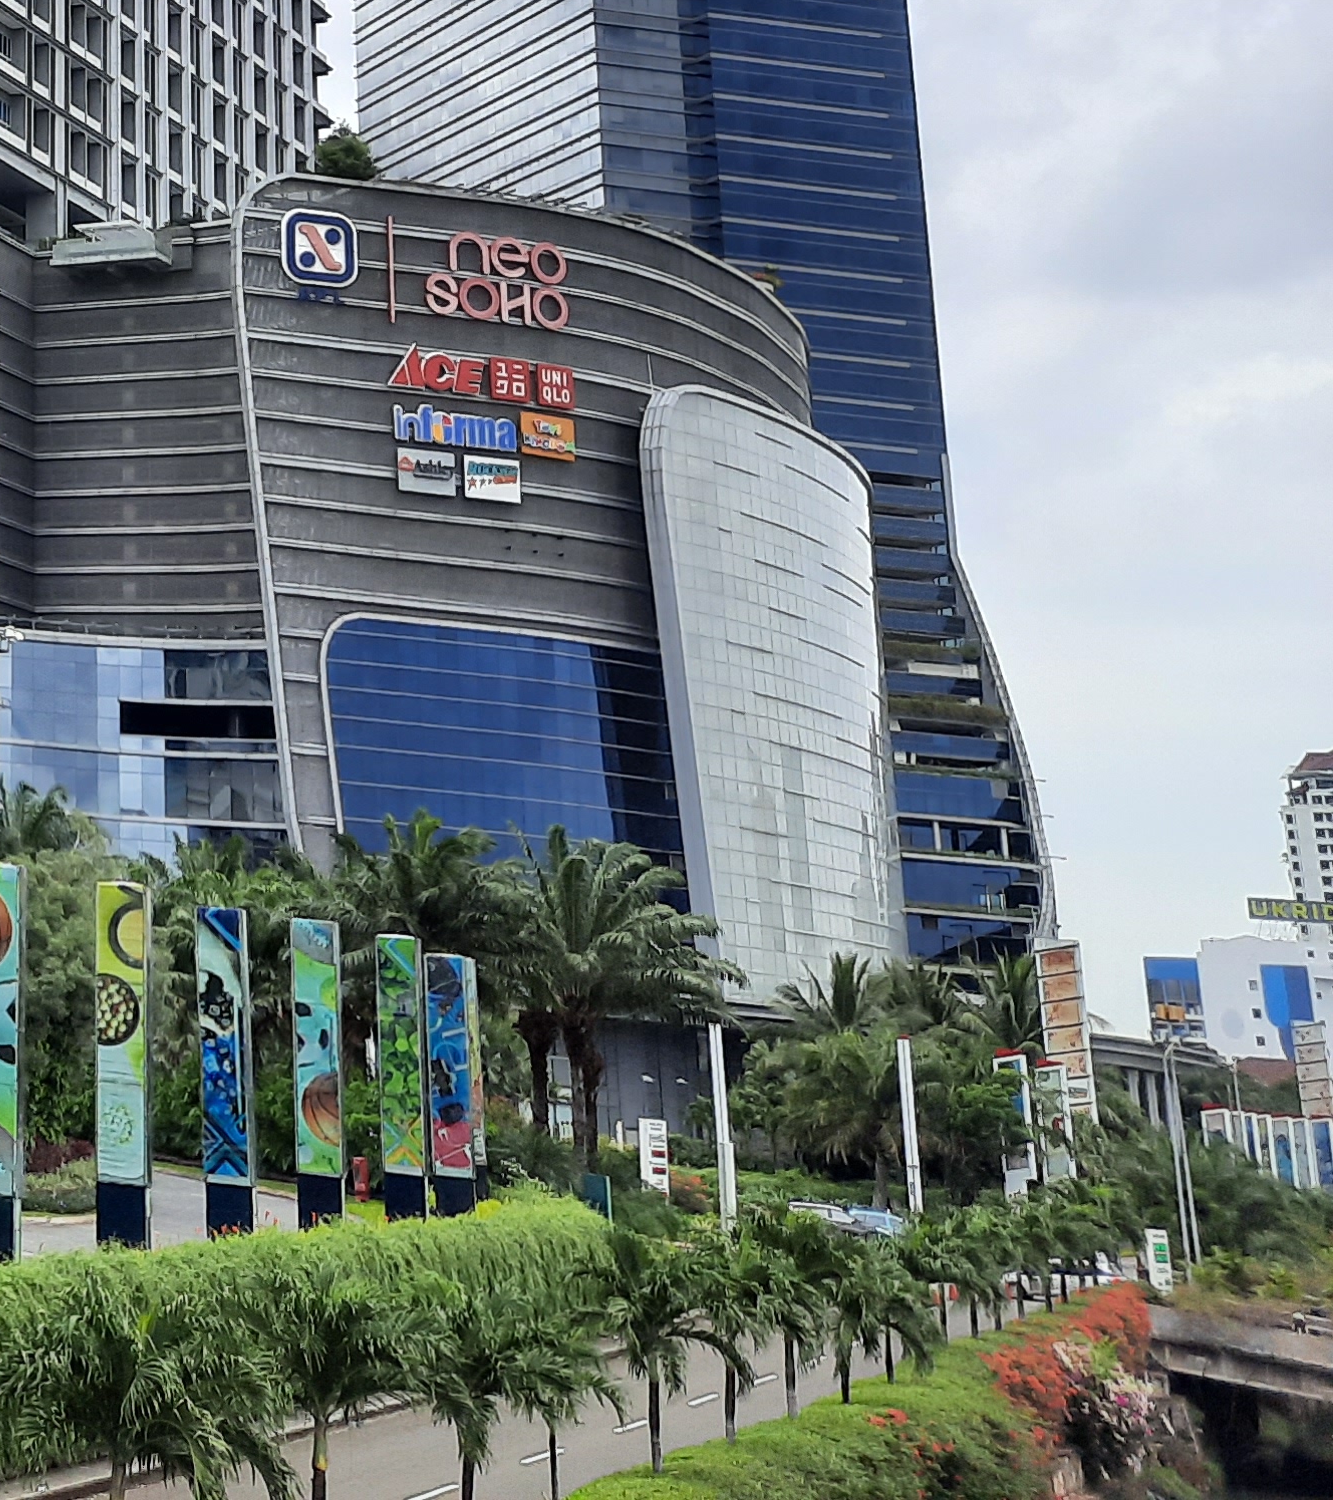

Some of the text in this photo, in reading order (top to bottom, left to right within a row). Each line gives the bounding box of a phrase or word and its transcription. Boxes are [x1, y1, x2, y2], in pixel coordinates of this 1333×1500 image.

[449, 232, 567, 284] neo
[426, 274, 569, 330] SOHO
[387, 342, 485, 396] ACE
[541, 368, 569, 387] UNI
[542, 389, 571, 405] QLO
[393, 403, 518, 453] informa
